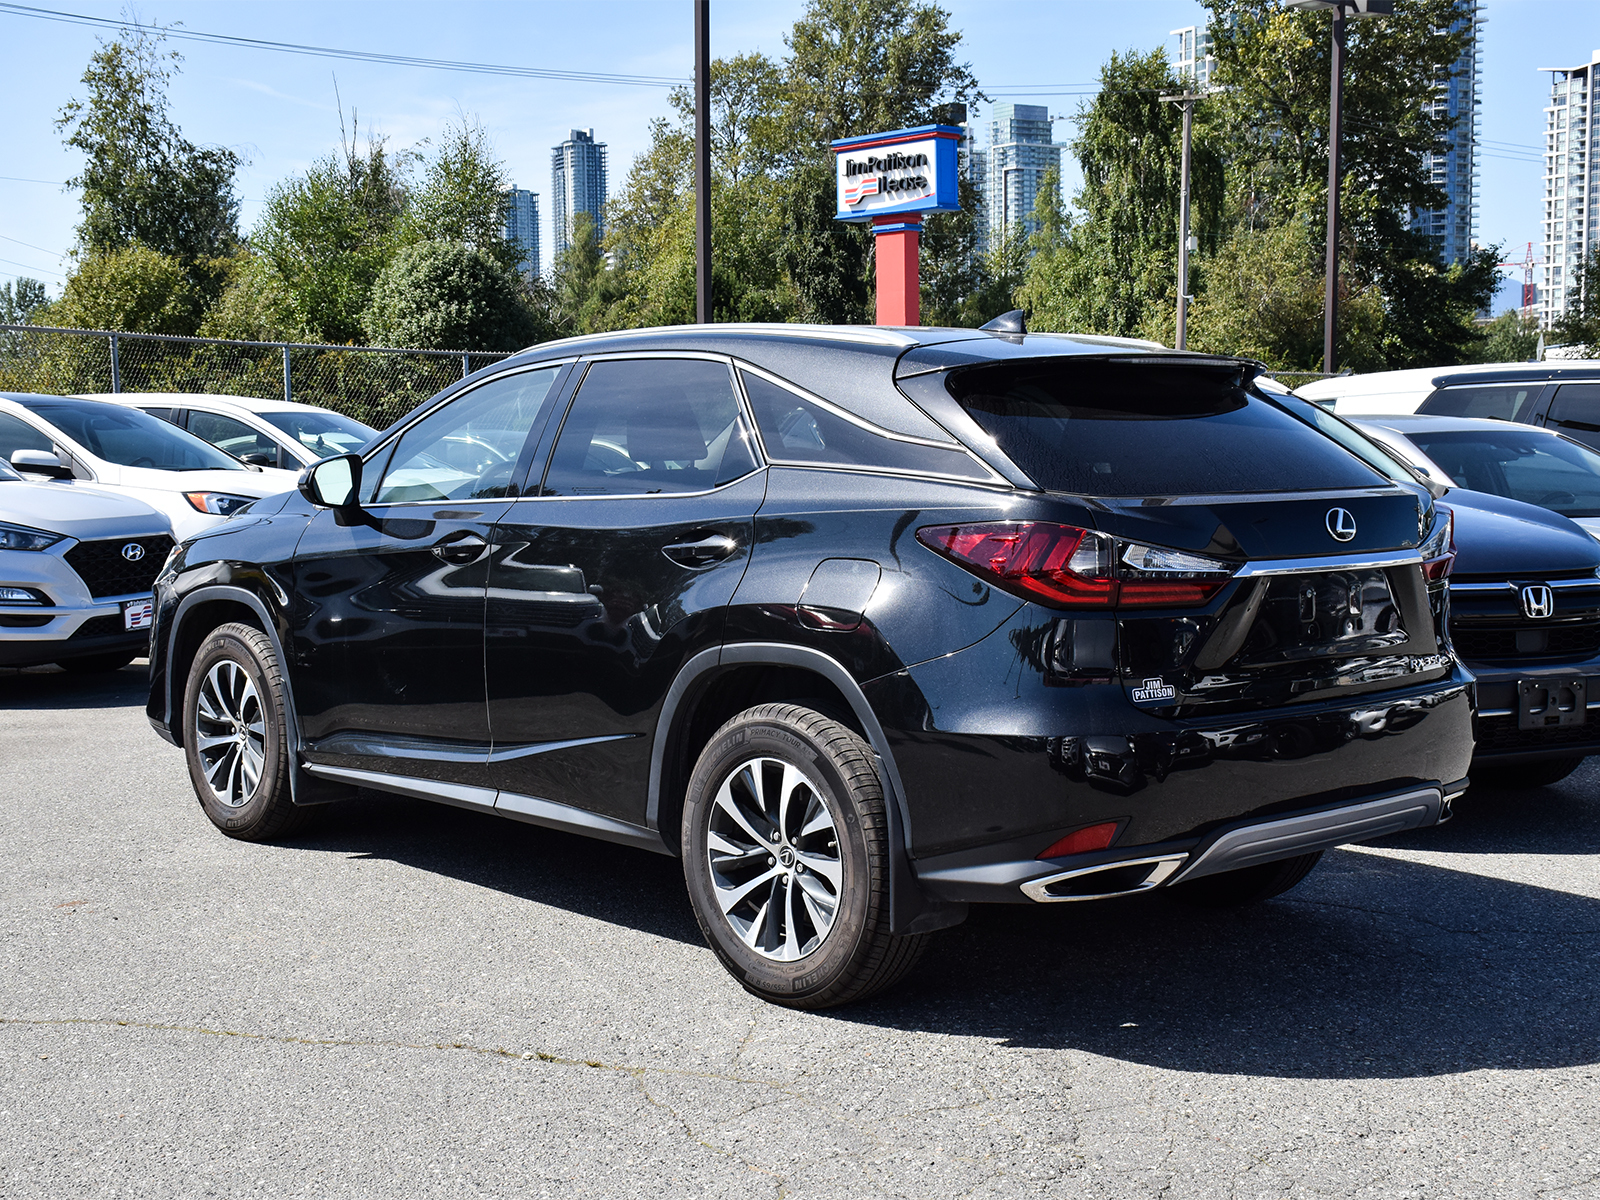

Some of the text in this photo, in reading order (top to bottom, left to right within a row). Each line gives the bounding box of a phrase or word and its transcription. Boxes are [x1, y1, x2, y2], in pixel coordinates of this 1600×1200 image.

[881, 174, 928, 193] Lease
[1145, 680, 1161, 690] JIM
[1134, 687, 1173, 700] PATTISON
[750, 728, 780, 738] PRIMACY
[781, 733, 801, 748] TOUR
